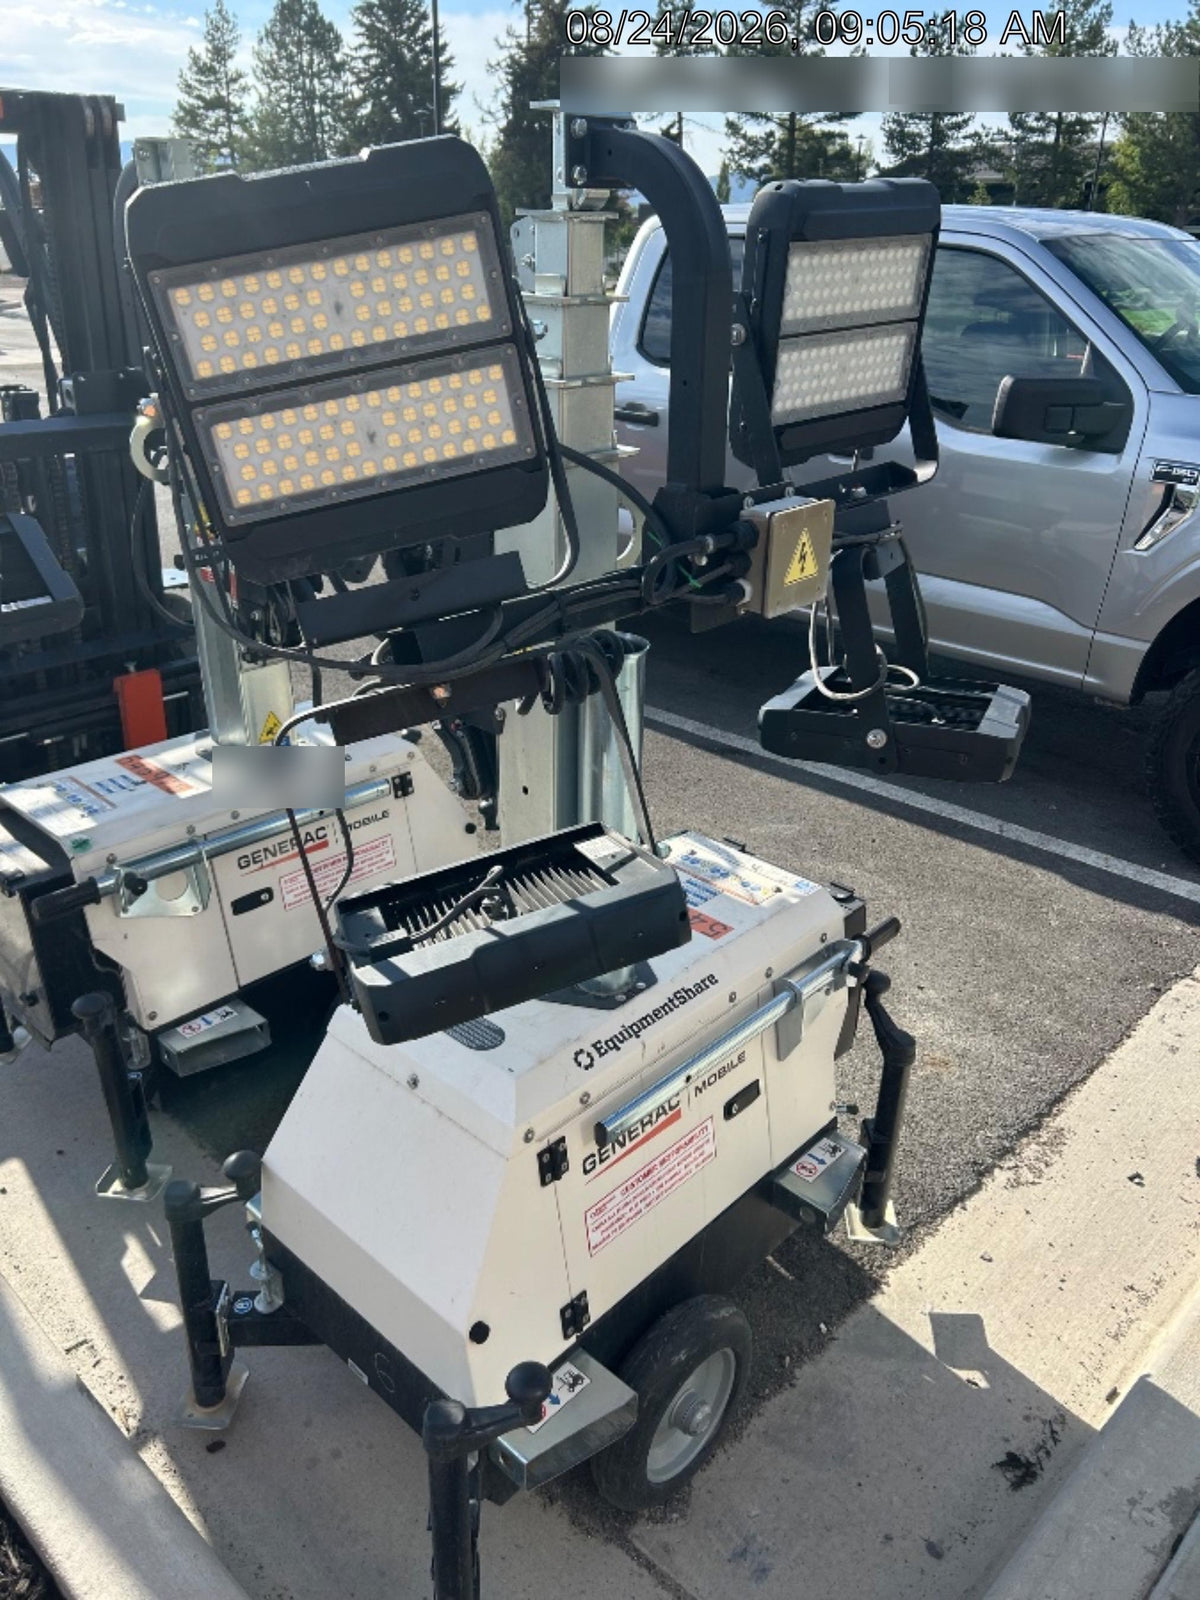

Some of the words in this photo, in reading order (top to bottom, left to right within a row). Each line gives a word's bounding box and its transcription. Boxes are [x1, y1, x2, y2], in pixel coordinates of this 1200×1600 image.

[591, 973, 719, 1059] EquipmentShare
[582, 1092, 681, 1176] GENERAC
[694, 1050, 746, 1098] MOBILE
